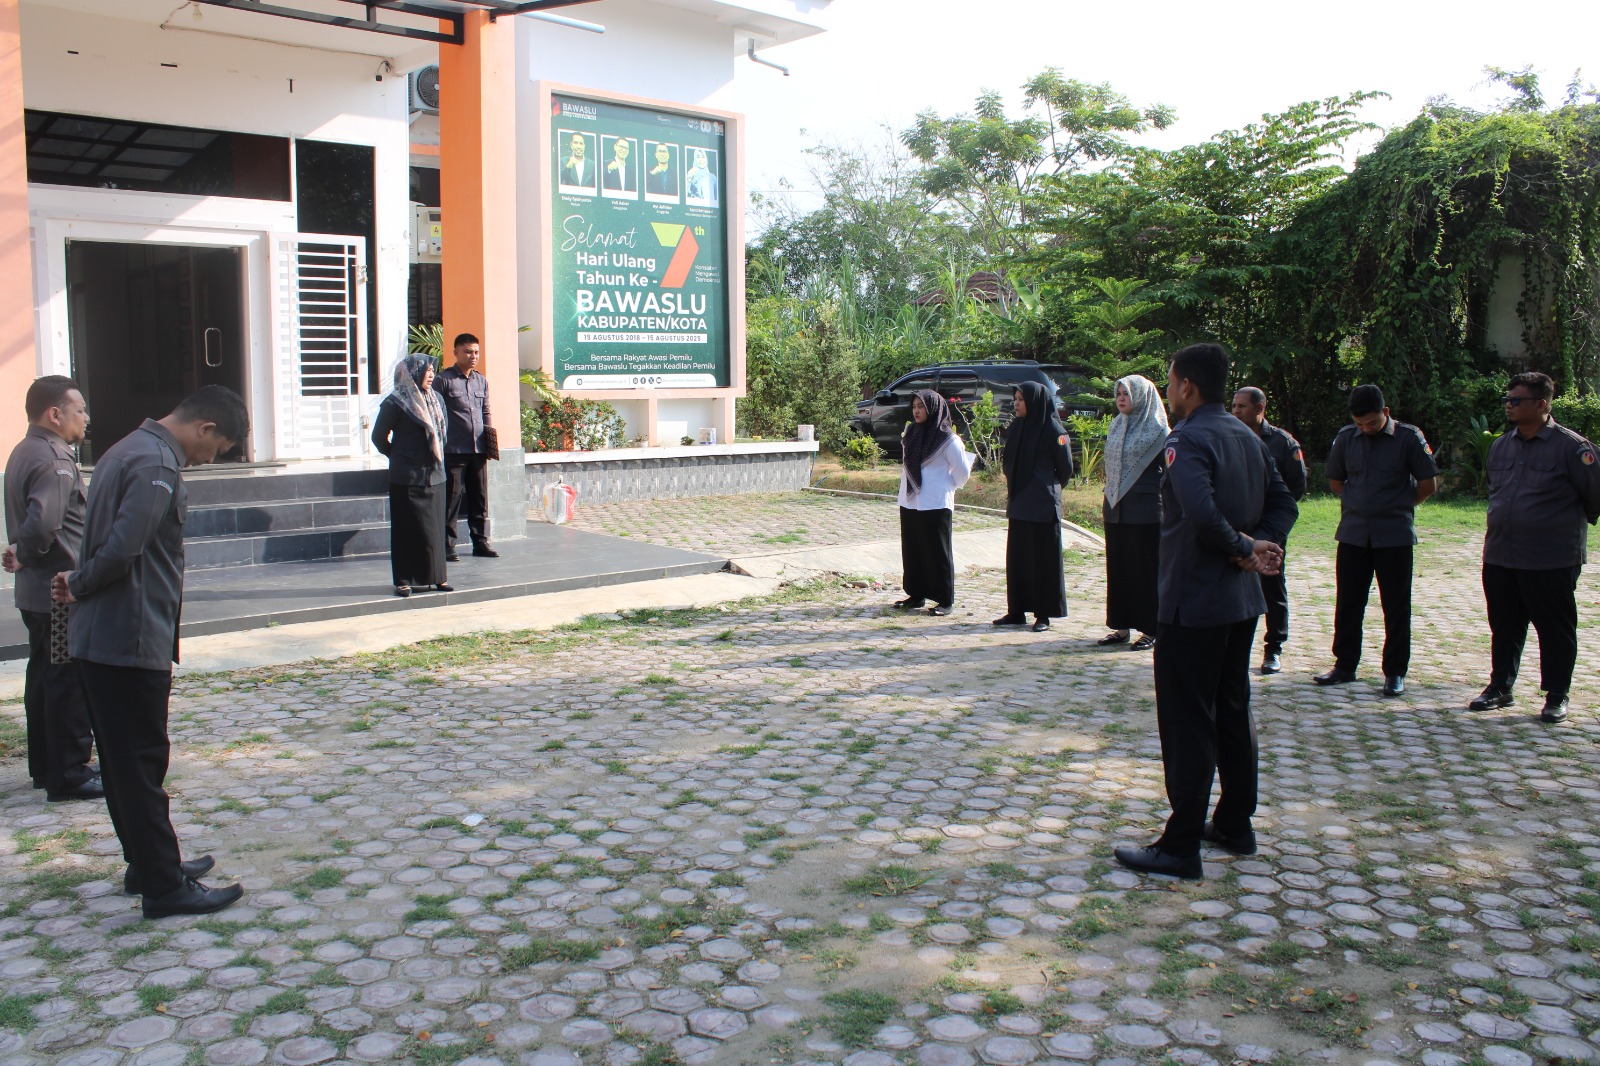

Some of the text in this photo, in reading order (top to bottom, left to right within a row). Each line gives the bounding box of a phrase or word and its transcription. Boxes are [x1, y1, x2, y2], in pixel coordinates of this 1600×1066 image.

[562, 103, 597, 114] BAWASLU
[561, 214, 639, 252] Selamat
[576, 252, 656, 272] Hari Ulang
[576, 271, 624, 286] Tahun
[629, 274, 649, 287] Ke
[576, 290, 706, 315] BAWASLU
[577, 314, 708, 331] KABUPATEN/KOTA
[623, 354, 647, 362] Rakyat
[564, 363, 597, 371] Bersama
[629, 363, 662, 372] Tegakkan
[663, 362, 692, 370] Keadilan
